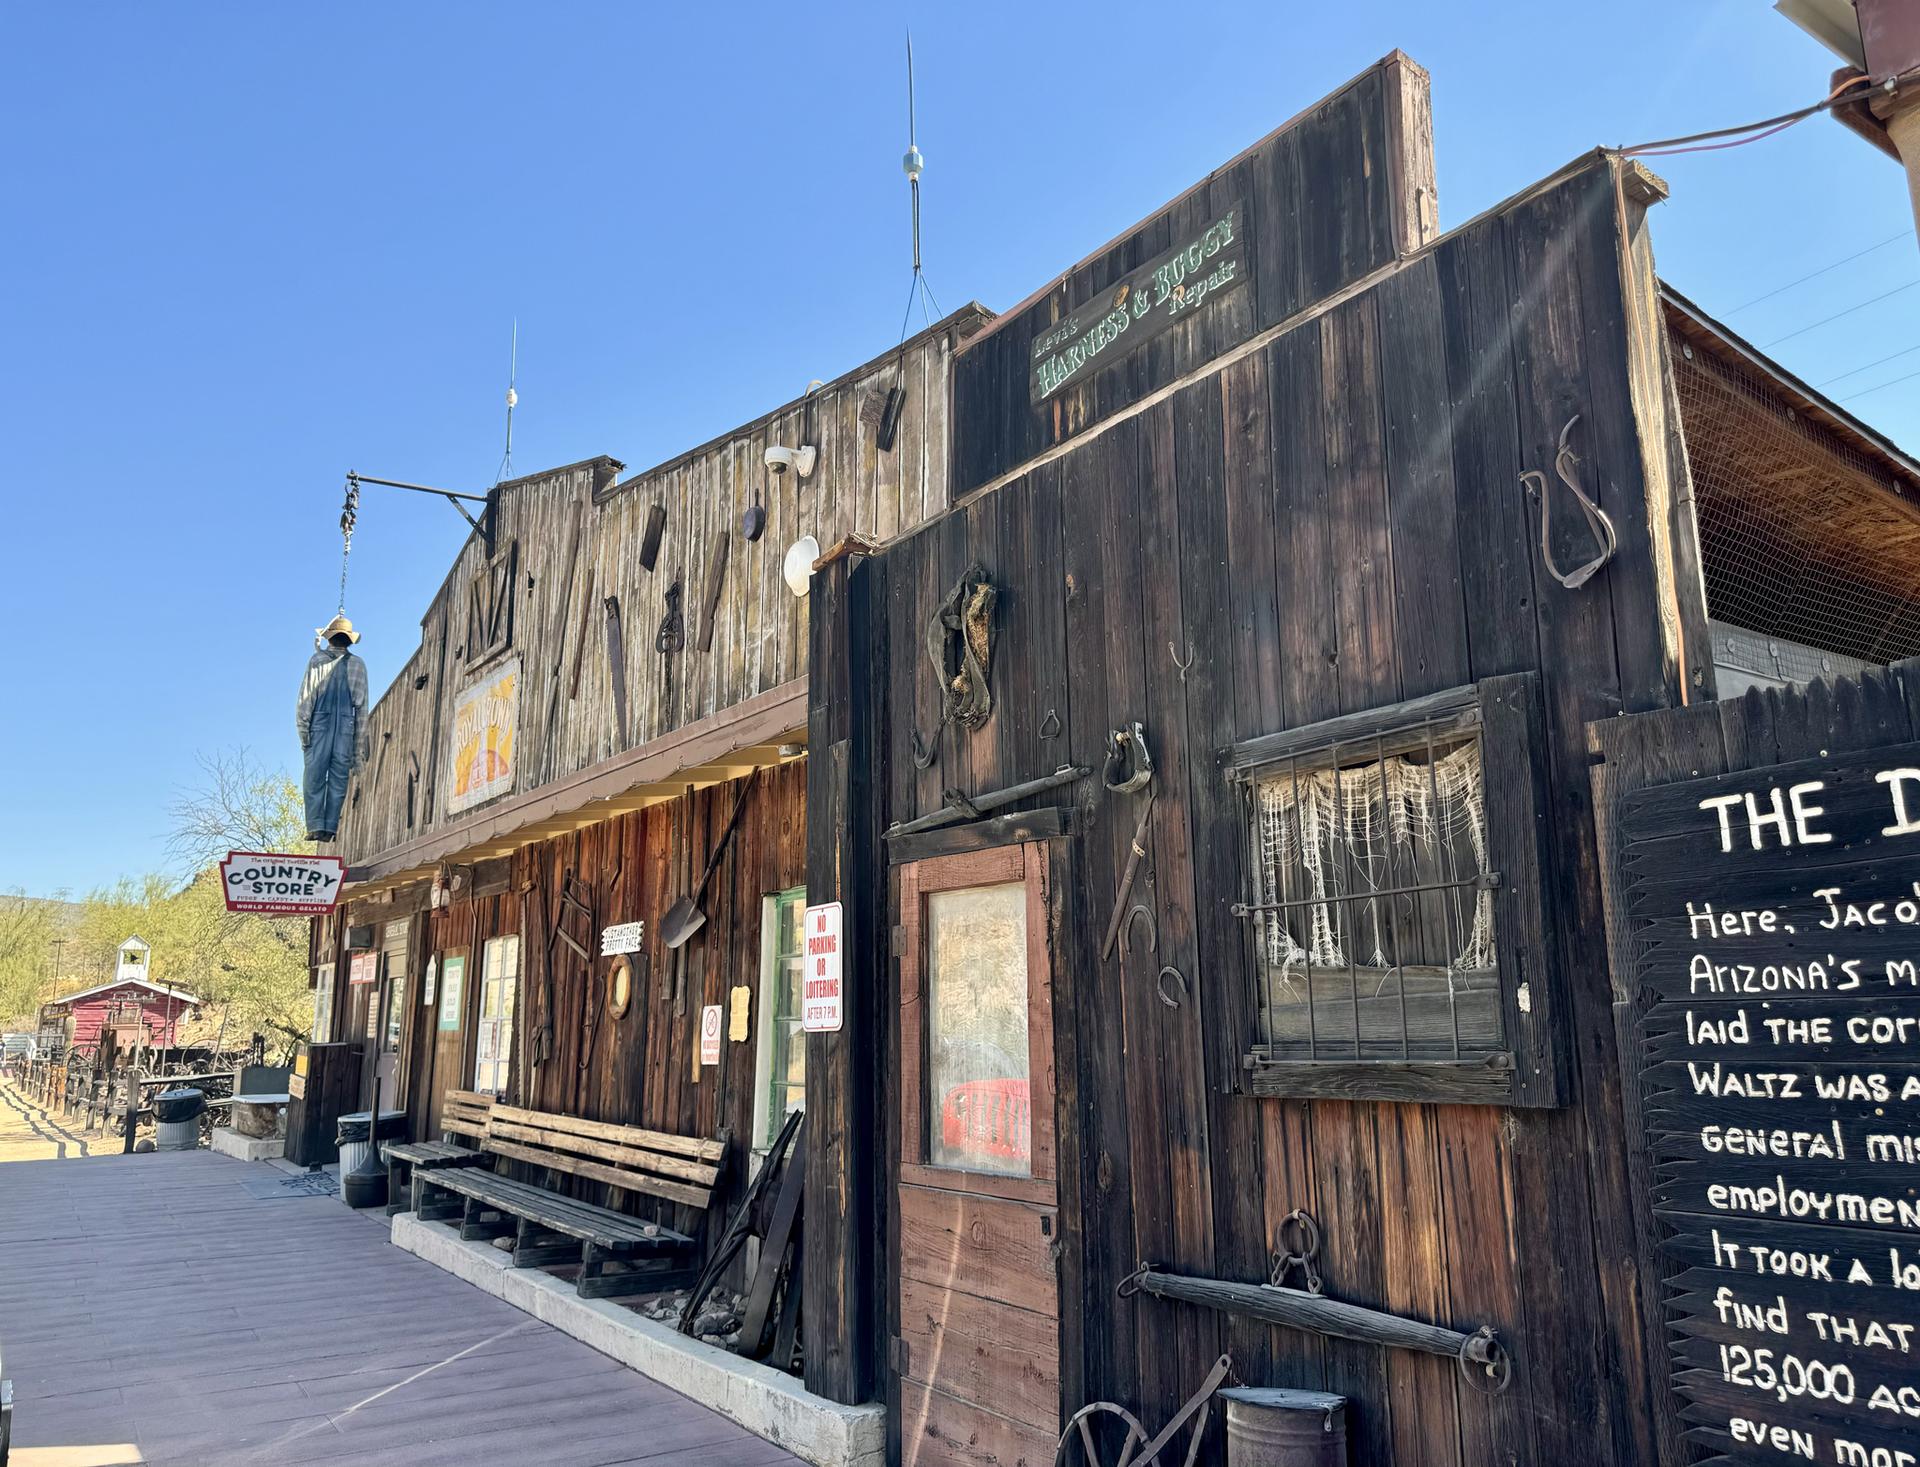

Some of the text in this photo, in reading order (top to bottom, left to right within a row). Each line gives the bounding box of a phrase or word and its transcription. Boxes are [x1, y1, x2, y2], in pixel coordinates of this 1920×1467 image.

[1036, 211, 1234, 399] HARNESS & BUGGY
[1169, 261, 1236, 315] Repair
[1699, 781, 1833, 852] THE
[228, 865, 338, 888] COUNTRY
[252, 881, 314, 896] STORE
[817, 914, 827, 933] NO
[1686, 882, 1920, 939] Here, JACO
[808, 934, 836, 956] PARKING
[816, 958, 826, 976] OR
[806, 978, 839, 999] LOITERING
[807, 1005, 838, 1020] AFTER 7 P.M.
[1763, 1017, 1833, 1045] THE
[1846, 1017, 1920, 1044] COr
[1687, 1062, 1802, 1098] WALTZ
[1815, 1074, 1891, 1102] WAS
[1749, 1246, 1832, 1282] TOOK
[1848, 1257, 1873, 1287] A
[1806, 1312, 1914, 1354] THAT
[1720, 1344, 1855, 1404] 125,000
